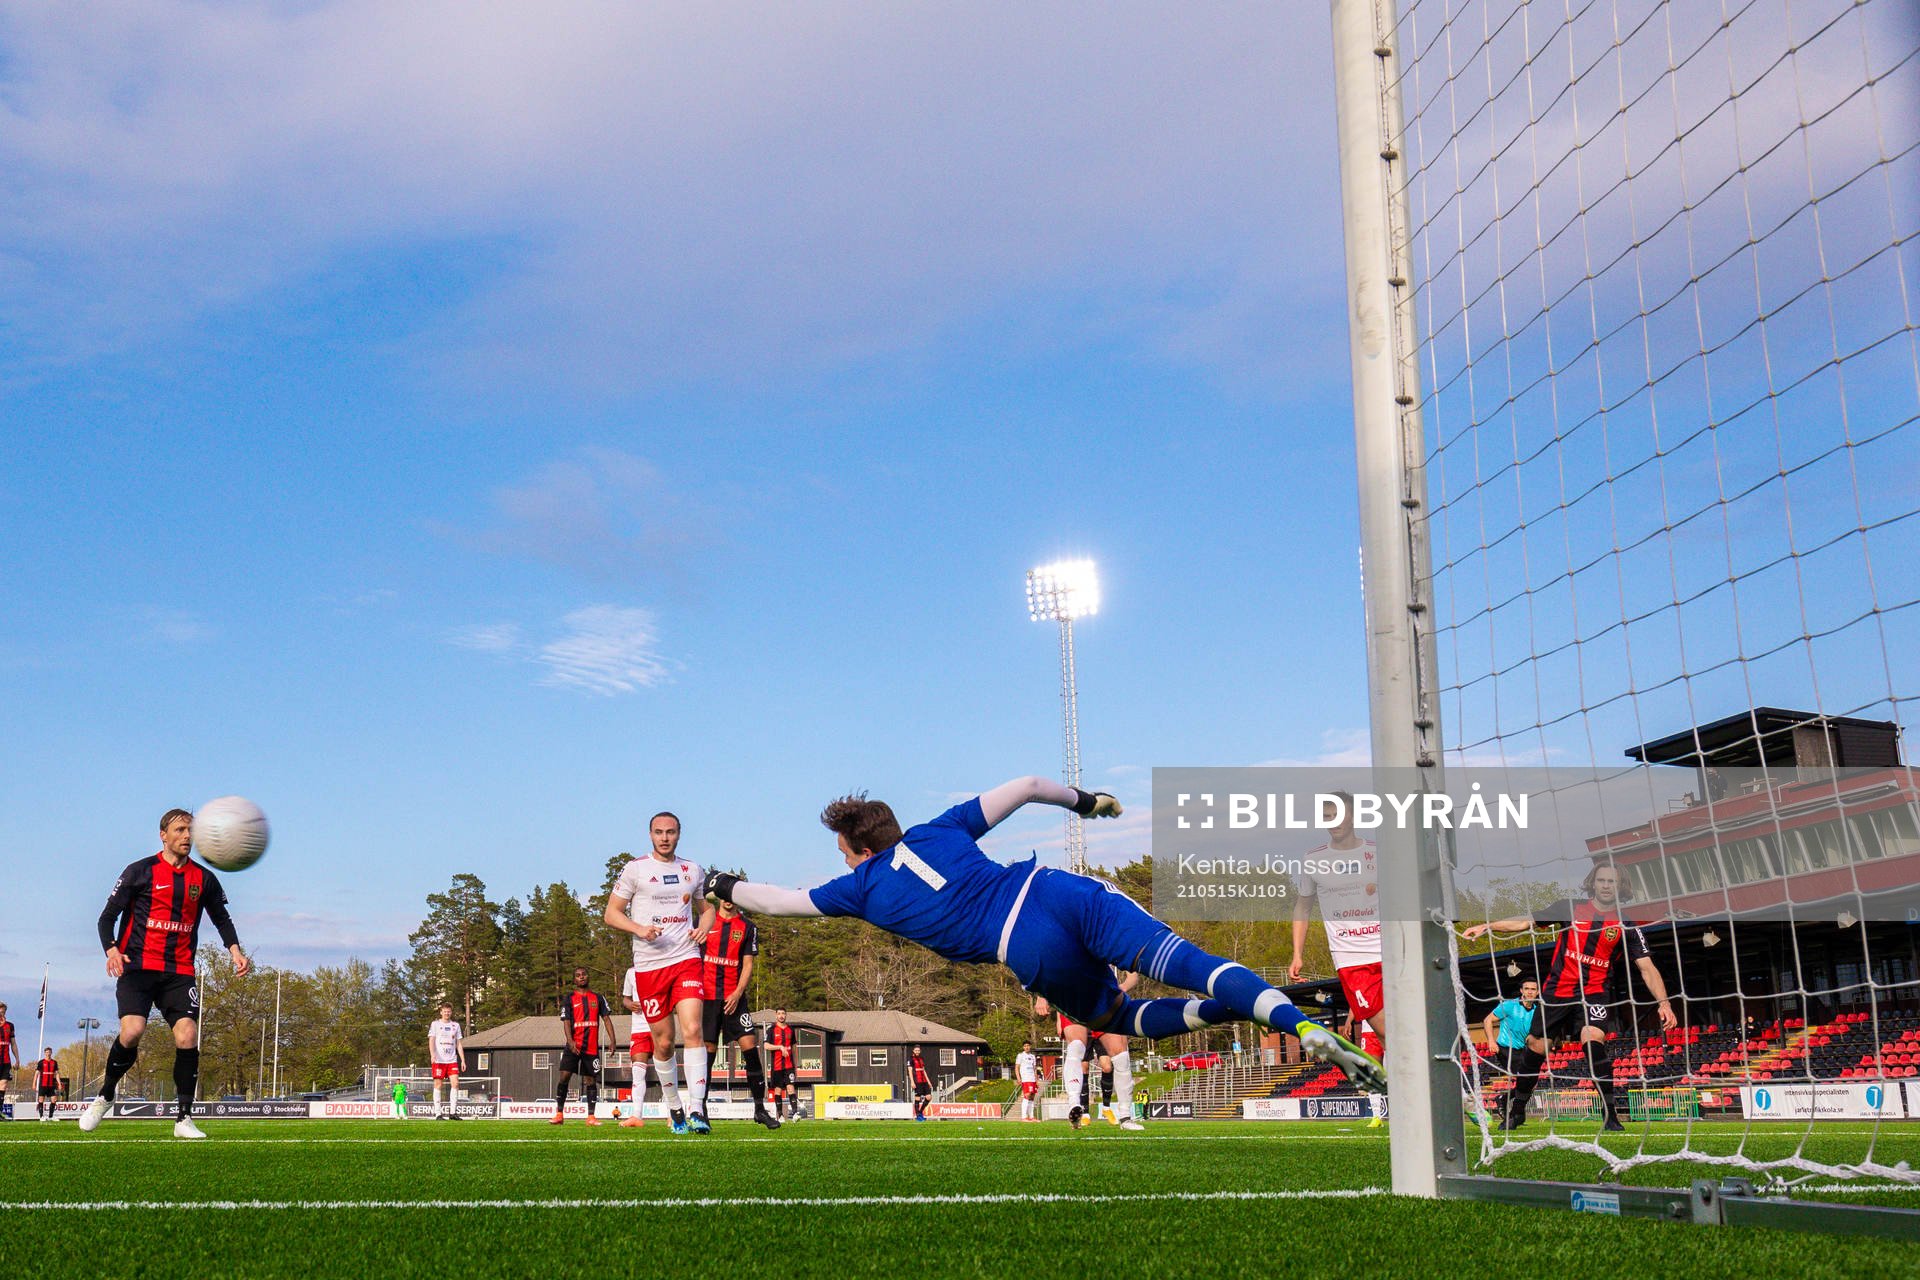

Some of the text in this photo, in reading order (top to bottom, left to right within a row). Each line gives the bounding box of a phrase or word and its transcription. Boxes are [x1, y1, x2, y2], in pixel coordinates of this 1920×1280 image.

[890, 841, 947, 891] 1
[662, 915, 688, 924] OilQuick
[1342, 909, 1376, 918] OilQuick
[148, 918, 193, 932] BAUHAUS
[1355, 989, 1370, 1009] 4
[643, 998, 661, 1017] 22
[228, 1105, 260, 1113] Stockholm
[274, 1105, 306, 1113] Stockholm
[456, 1105, 493, 1115] SERNEKE
[509, 1106, 552, 1114] WESTIN
[1321, 1101, 1360, 1116] SUPERCOACH
